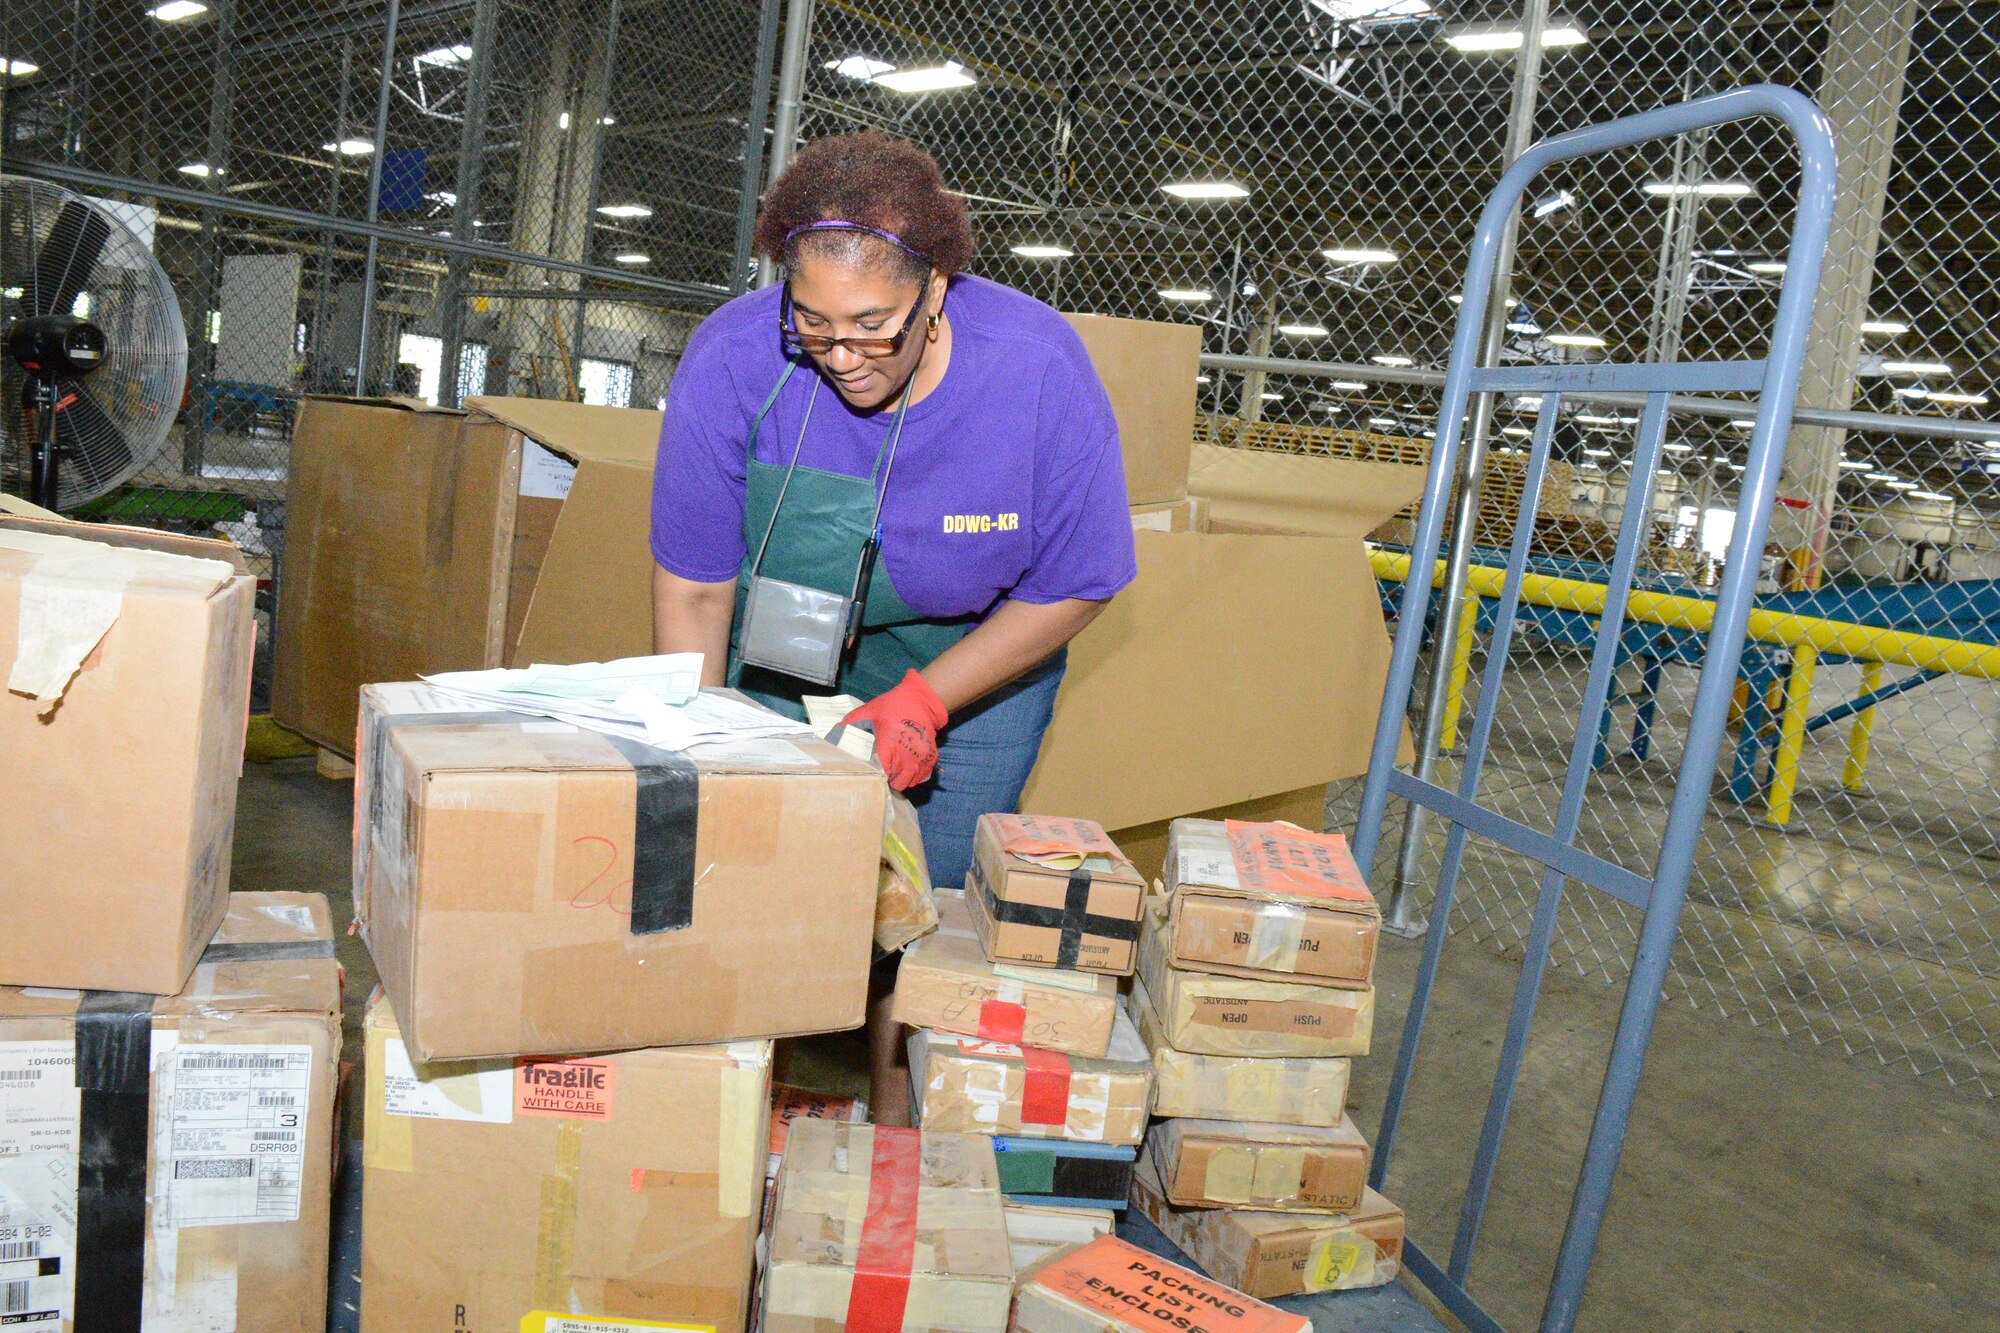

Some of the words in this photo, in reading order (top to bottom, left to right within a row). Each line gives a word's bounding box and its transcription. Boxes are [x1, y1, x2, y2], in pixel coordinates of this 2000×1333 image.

[943, 513, 1019, 534] DDWG-KR
[1233, 931, 1250, 945] EN
[1222, 1013, 1247, 1023] OPEN
[1294, 1015, 1321, 1025] PUSH
[524, 1065, 605, 1089] fragile
[535, 1087, 594, 1100] HANDLE
[523, 1097, 559, 1108] WITH
[564, 1100, 605, 1112] CARE
[280, 1114, 298, 1127] 3
[250, 1143, 298, 1153] DSRA00
[1292, 1262, 1305, 1272] EN
[1128, 1262, 1245, 1318] PACKING
[1140, 1285, 1201, 1313] LIST
[455, 1304, 466, 1326] R
